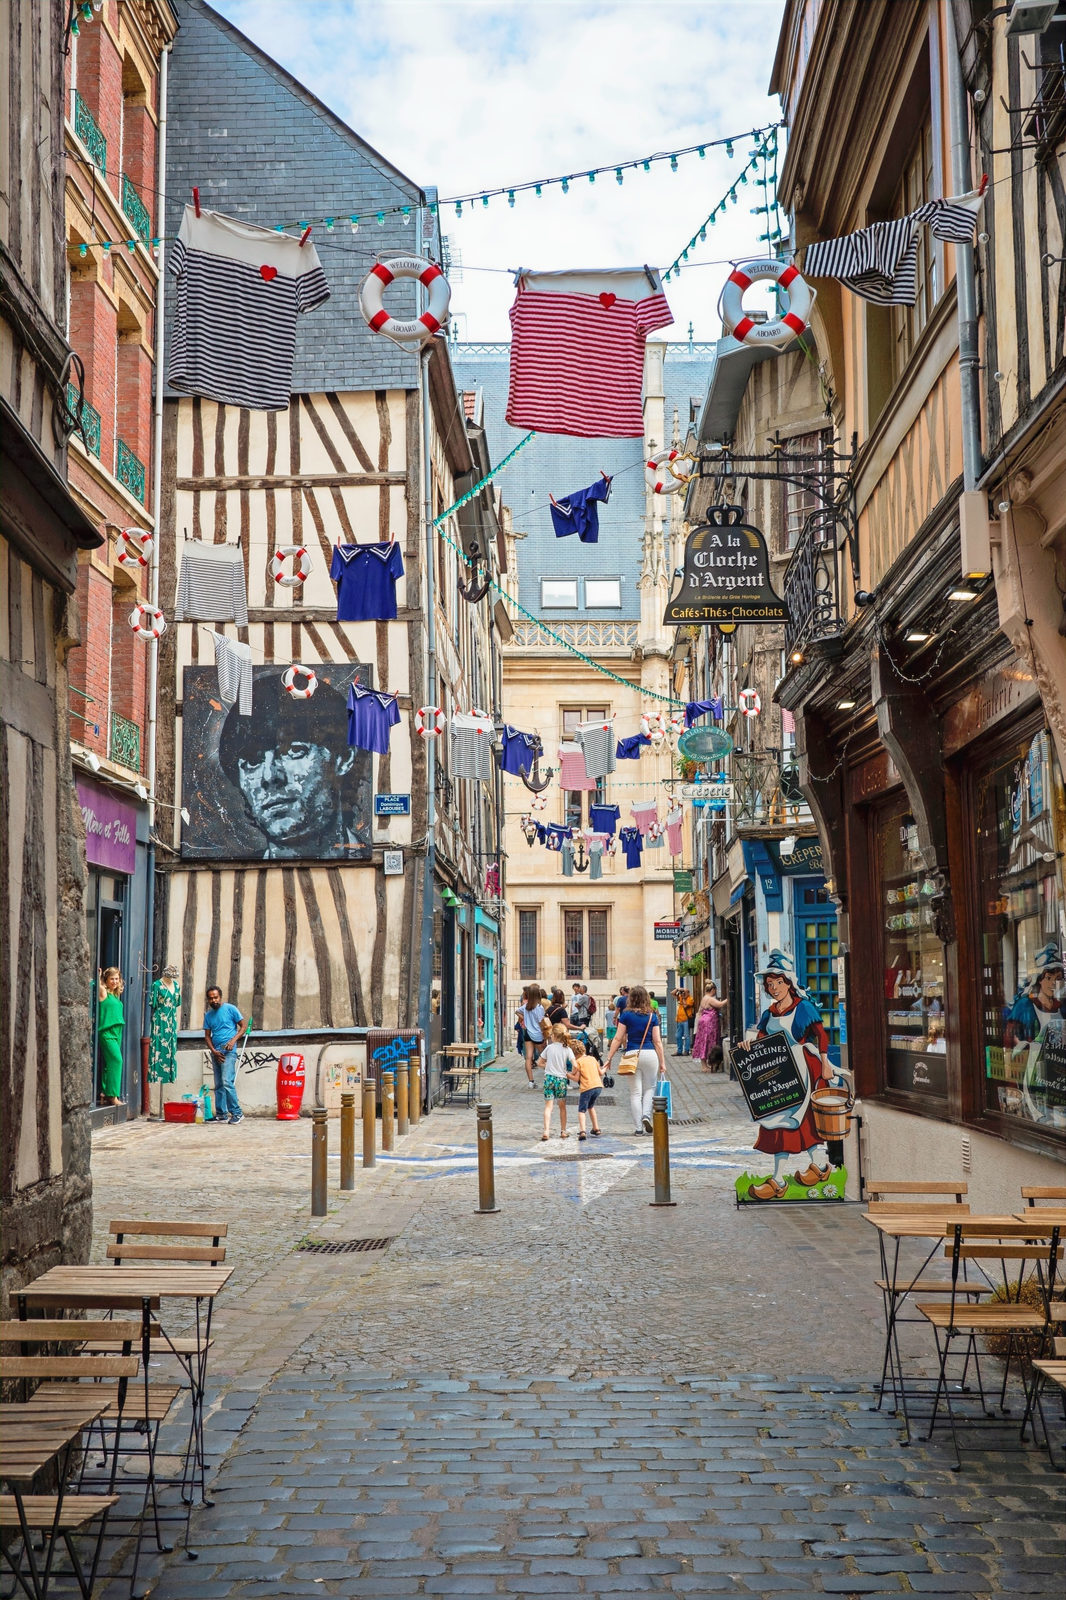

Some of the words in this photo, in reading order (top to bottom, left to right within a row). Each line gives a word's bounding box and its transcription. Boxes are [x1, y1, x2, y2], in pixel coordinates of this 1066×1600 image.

[390, 261, 421, 270] WELCOME
[747, 264, 779, 274] WELCOME
[391, 324, 417, 332] ABOARD
[755, 328, 781, 337] ABOARD
[710, 535, 722, 547] A
[728, 535, 740, 547] la
[693, 551, 758, 570] Cloche
[689, 572, 764, 590] d'Argent
[681, 727, 704, 741] SALON
[682, 785, 731, 797] Crêperie
[81, 806, 103, 836] Mère
[764, 878, 774, 890] 12
[737, 1045, 787, 1069] MADELEINES
[741, 1055, 788, 1081] Jeannette
[750, 1089, 771, 1101] Cloche
[772, 1078, 799, 1092] d'Argent
